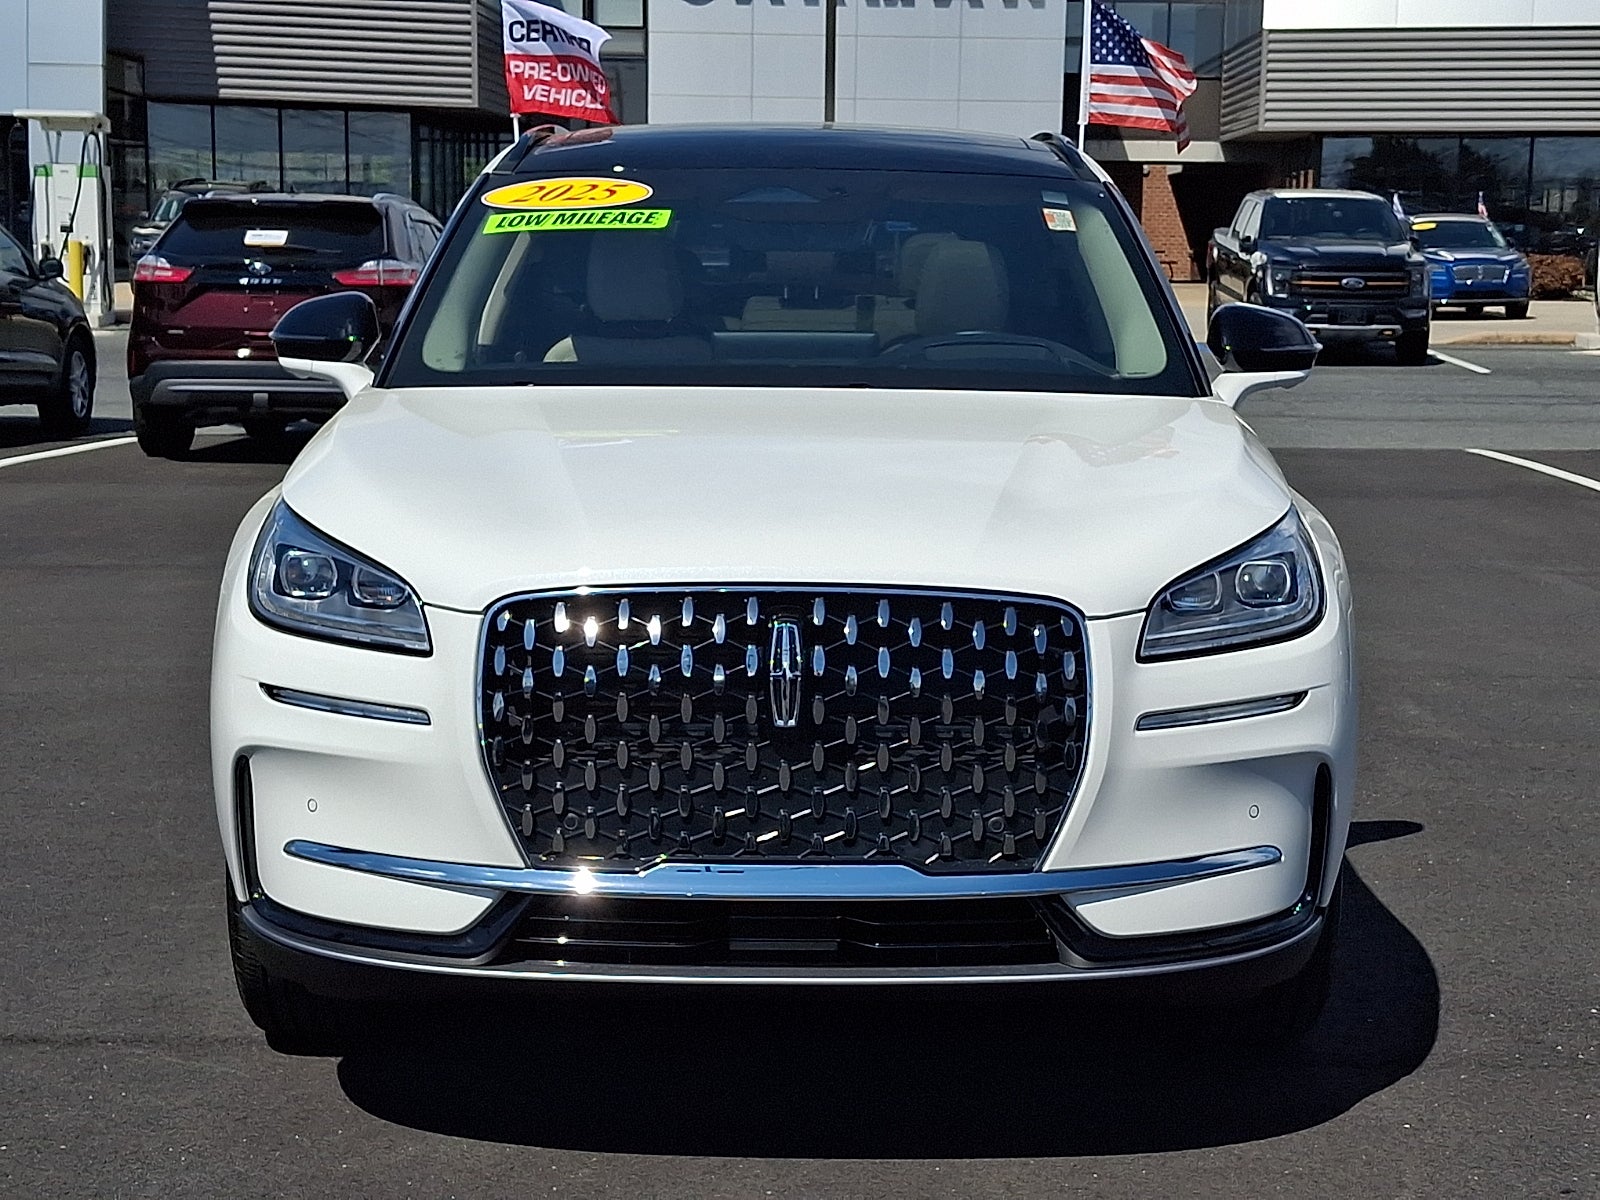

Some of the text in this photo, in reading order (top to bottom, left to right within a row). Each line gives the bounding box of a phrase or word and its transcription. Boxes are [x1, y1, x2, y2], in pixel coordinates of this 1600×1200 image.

[509, 60, 607, 95] PRE-OWED
[508, 184, 629, 203] 2025
[495, 211, 659, 229] LOW MILEAGE
